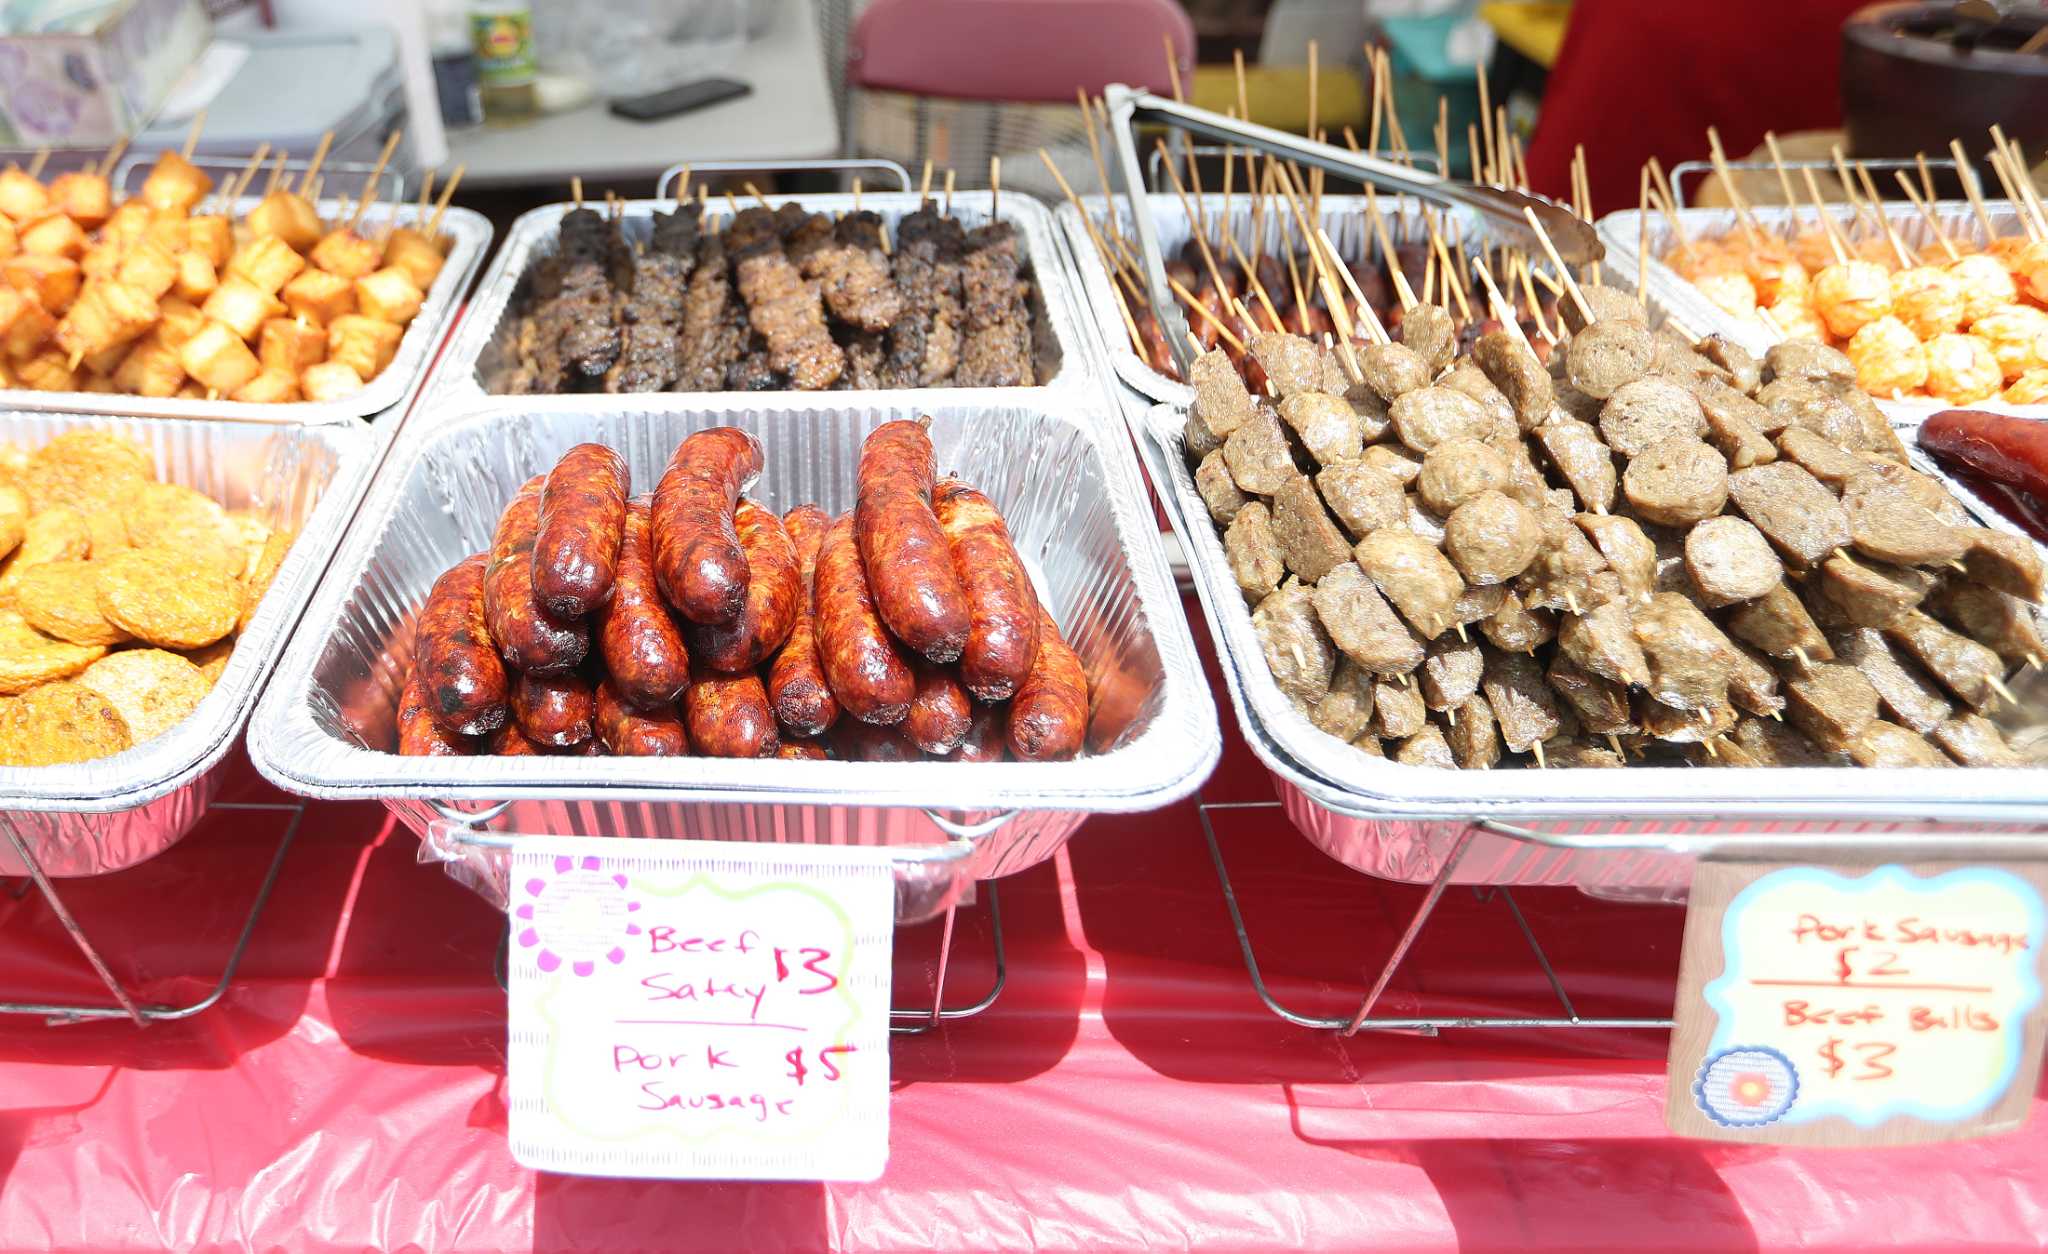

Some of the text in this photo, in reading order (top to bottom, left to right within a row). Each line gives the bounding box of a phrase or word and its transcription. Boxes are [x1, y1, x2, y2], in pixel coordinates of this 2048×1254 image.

[649, 926, 760, 954] Beef
[1792, 914, 1885, 943] Pork
[1833, 945, 1910, 983] $2
[1784, 1000, 2000, 1032] Beef Balls
[613, 1044, 858, 1086] Pork $5
[1817, 1036, 1897, 1080] $3
[637, 1081, 794, 1122] Sausage
